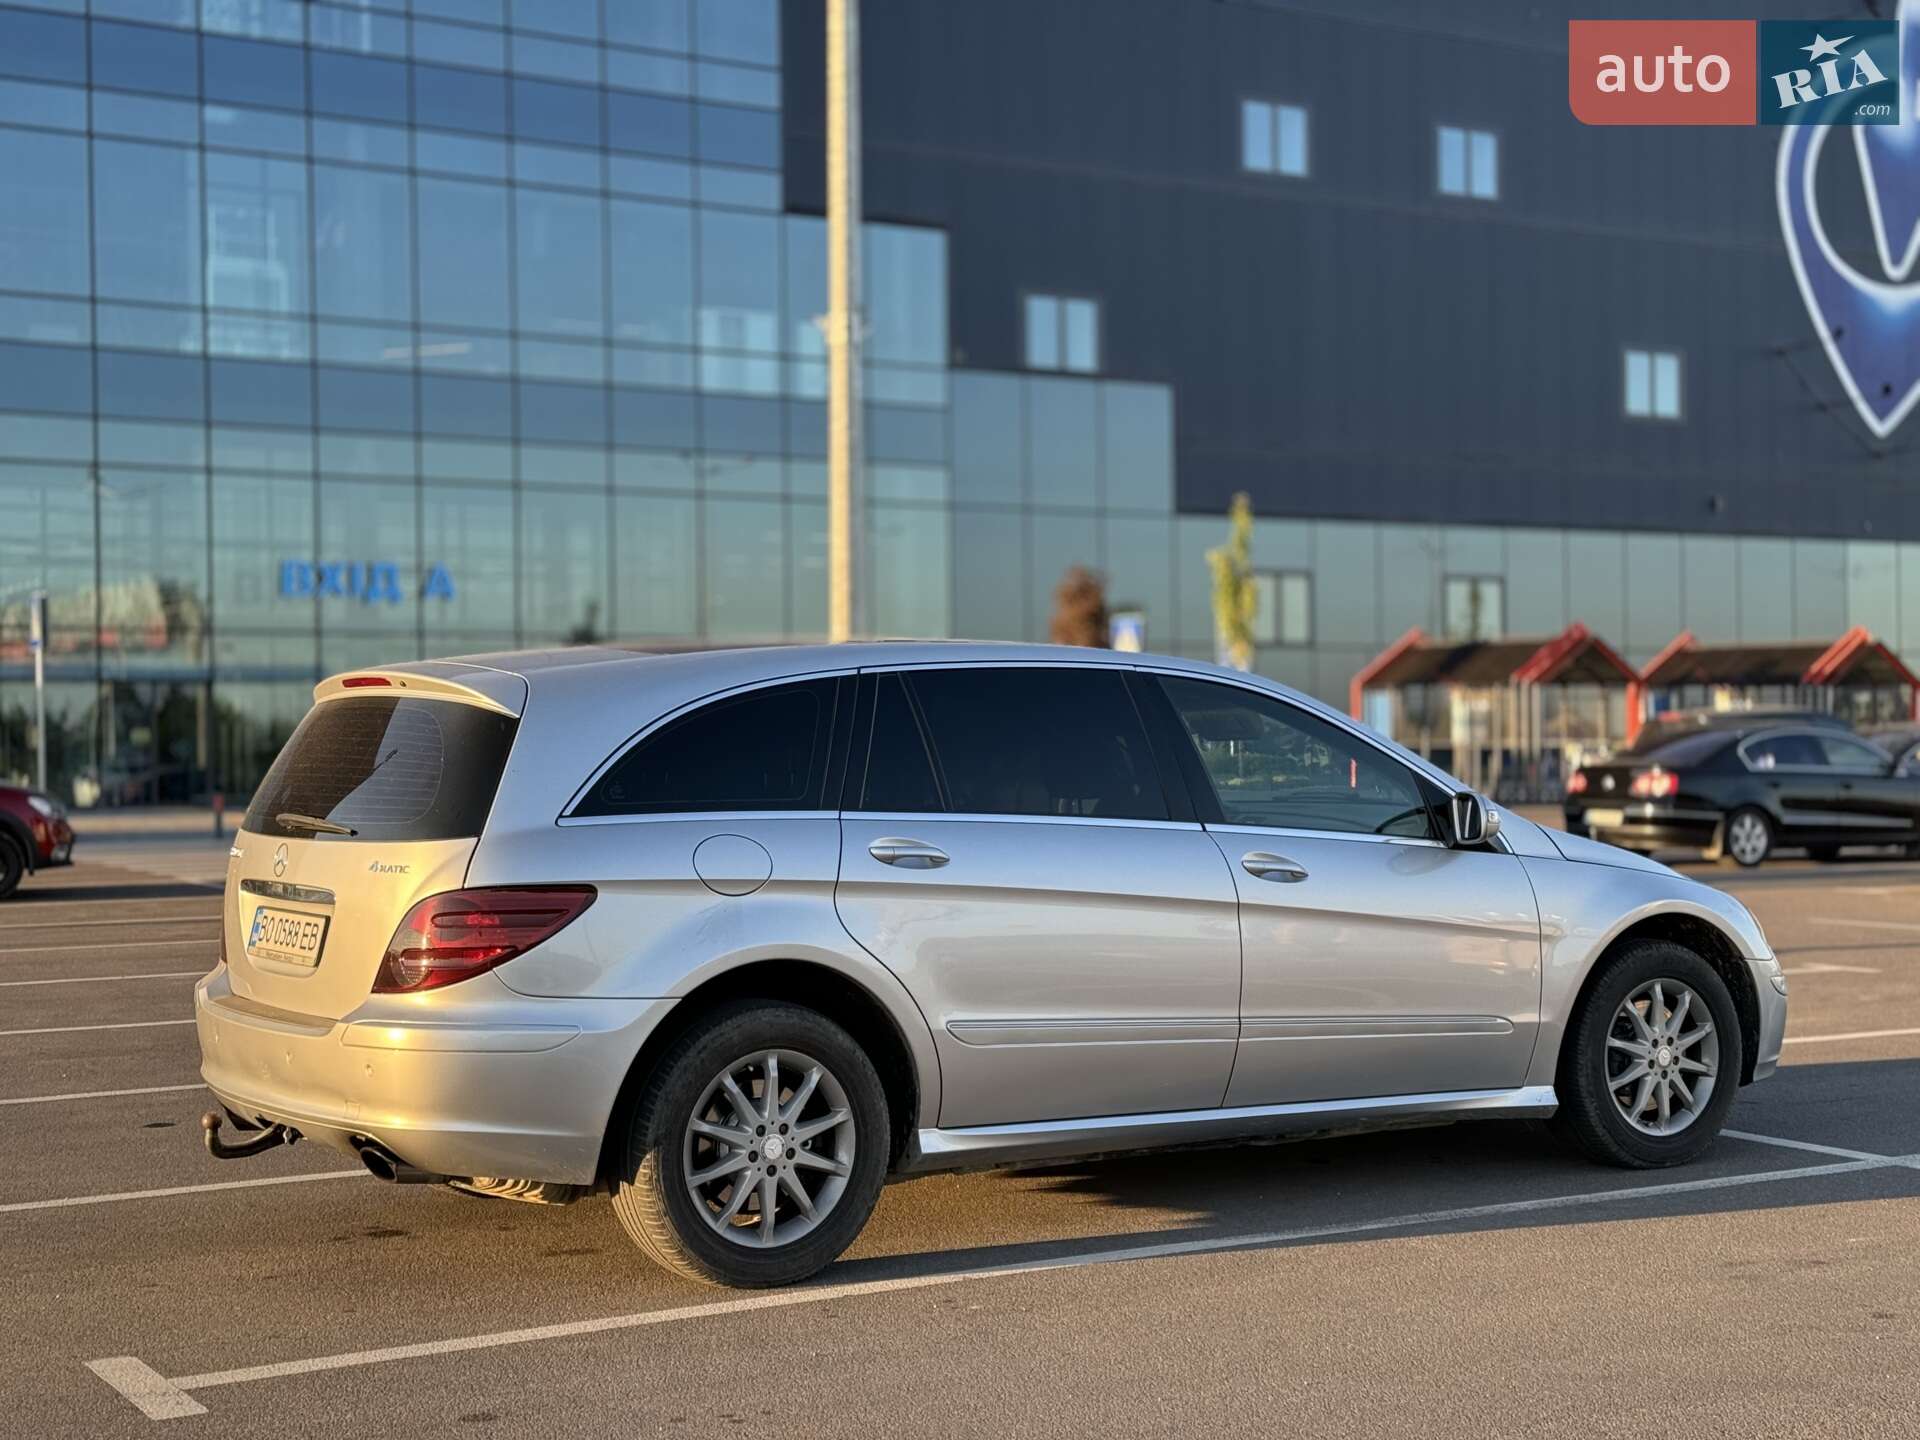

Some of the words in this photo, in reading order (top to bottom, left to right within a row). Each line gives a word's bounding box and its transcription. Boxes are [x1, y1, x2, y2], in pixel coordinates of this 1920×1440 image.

[281, 560, 402, 604] ВХІД
[275, 919, 298, 948] 0588
[300, 922, 319, 951] EB
